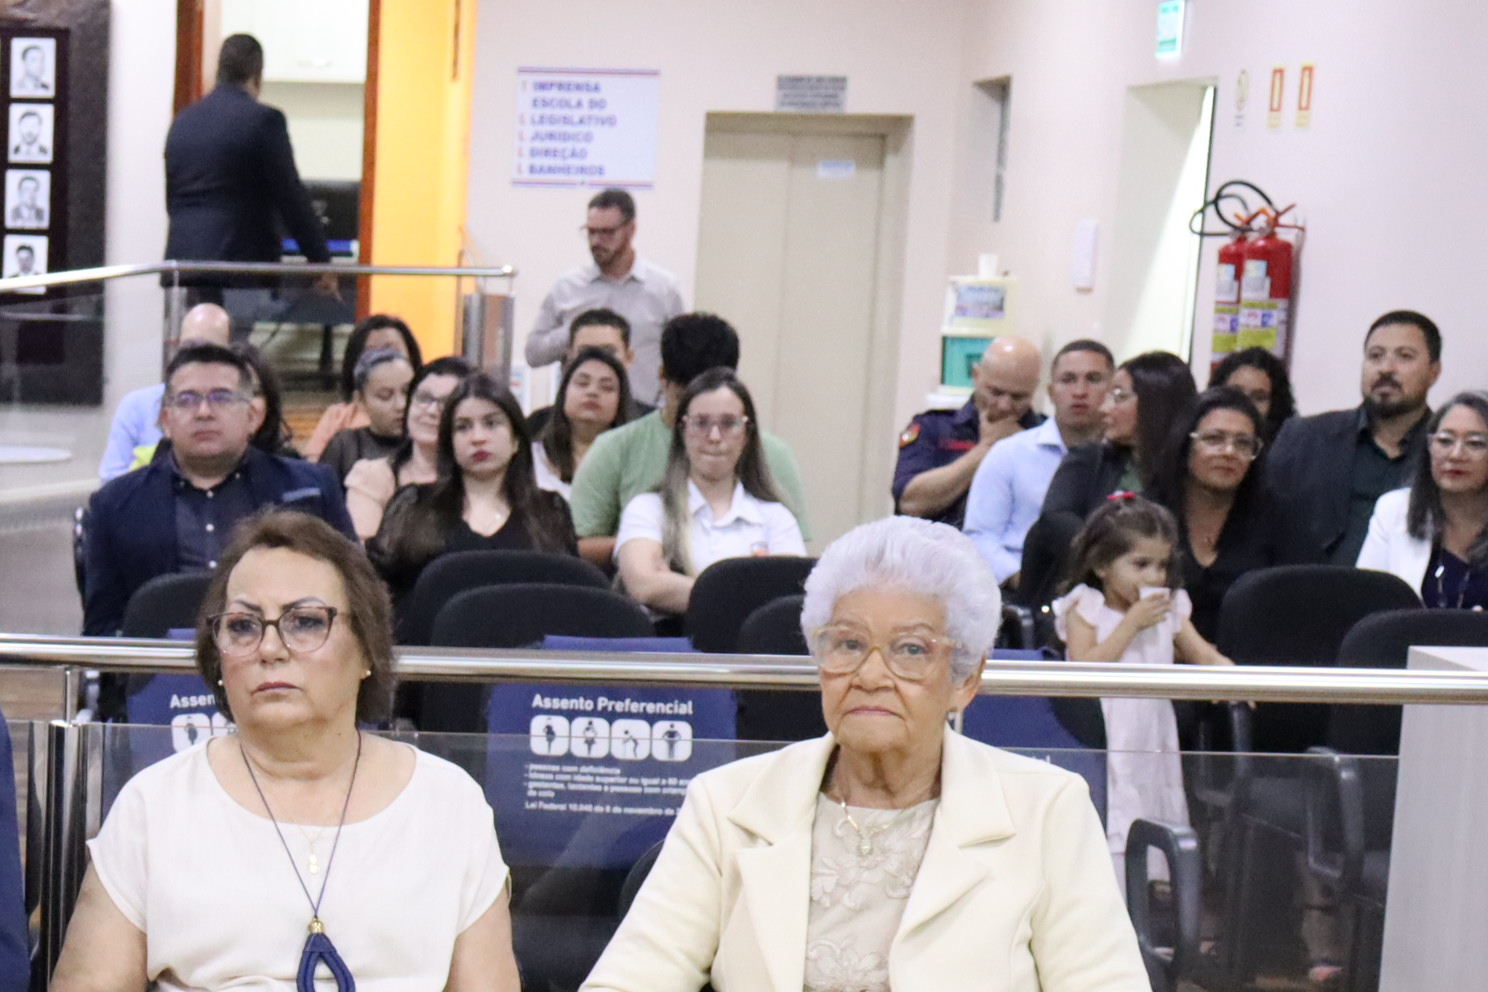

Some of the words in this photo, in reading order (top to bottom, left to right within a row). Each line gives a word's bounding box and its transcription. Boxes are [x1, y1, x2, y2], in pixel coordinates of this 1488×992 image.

[533, 81, 601, 93] IMPRENSA
[532, 98, 583, 110] ESCOLA
[588, 98, 607, 110] DO
[530, 114, 617, 126] LEGISLATIVO
[529, 164, 605, 176] BANHEIROS
[169, 694, 216, 709] Assen
[532, 693, 594, 711] Assento
[597, 696, 694, 715] Preferencial
